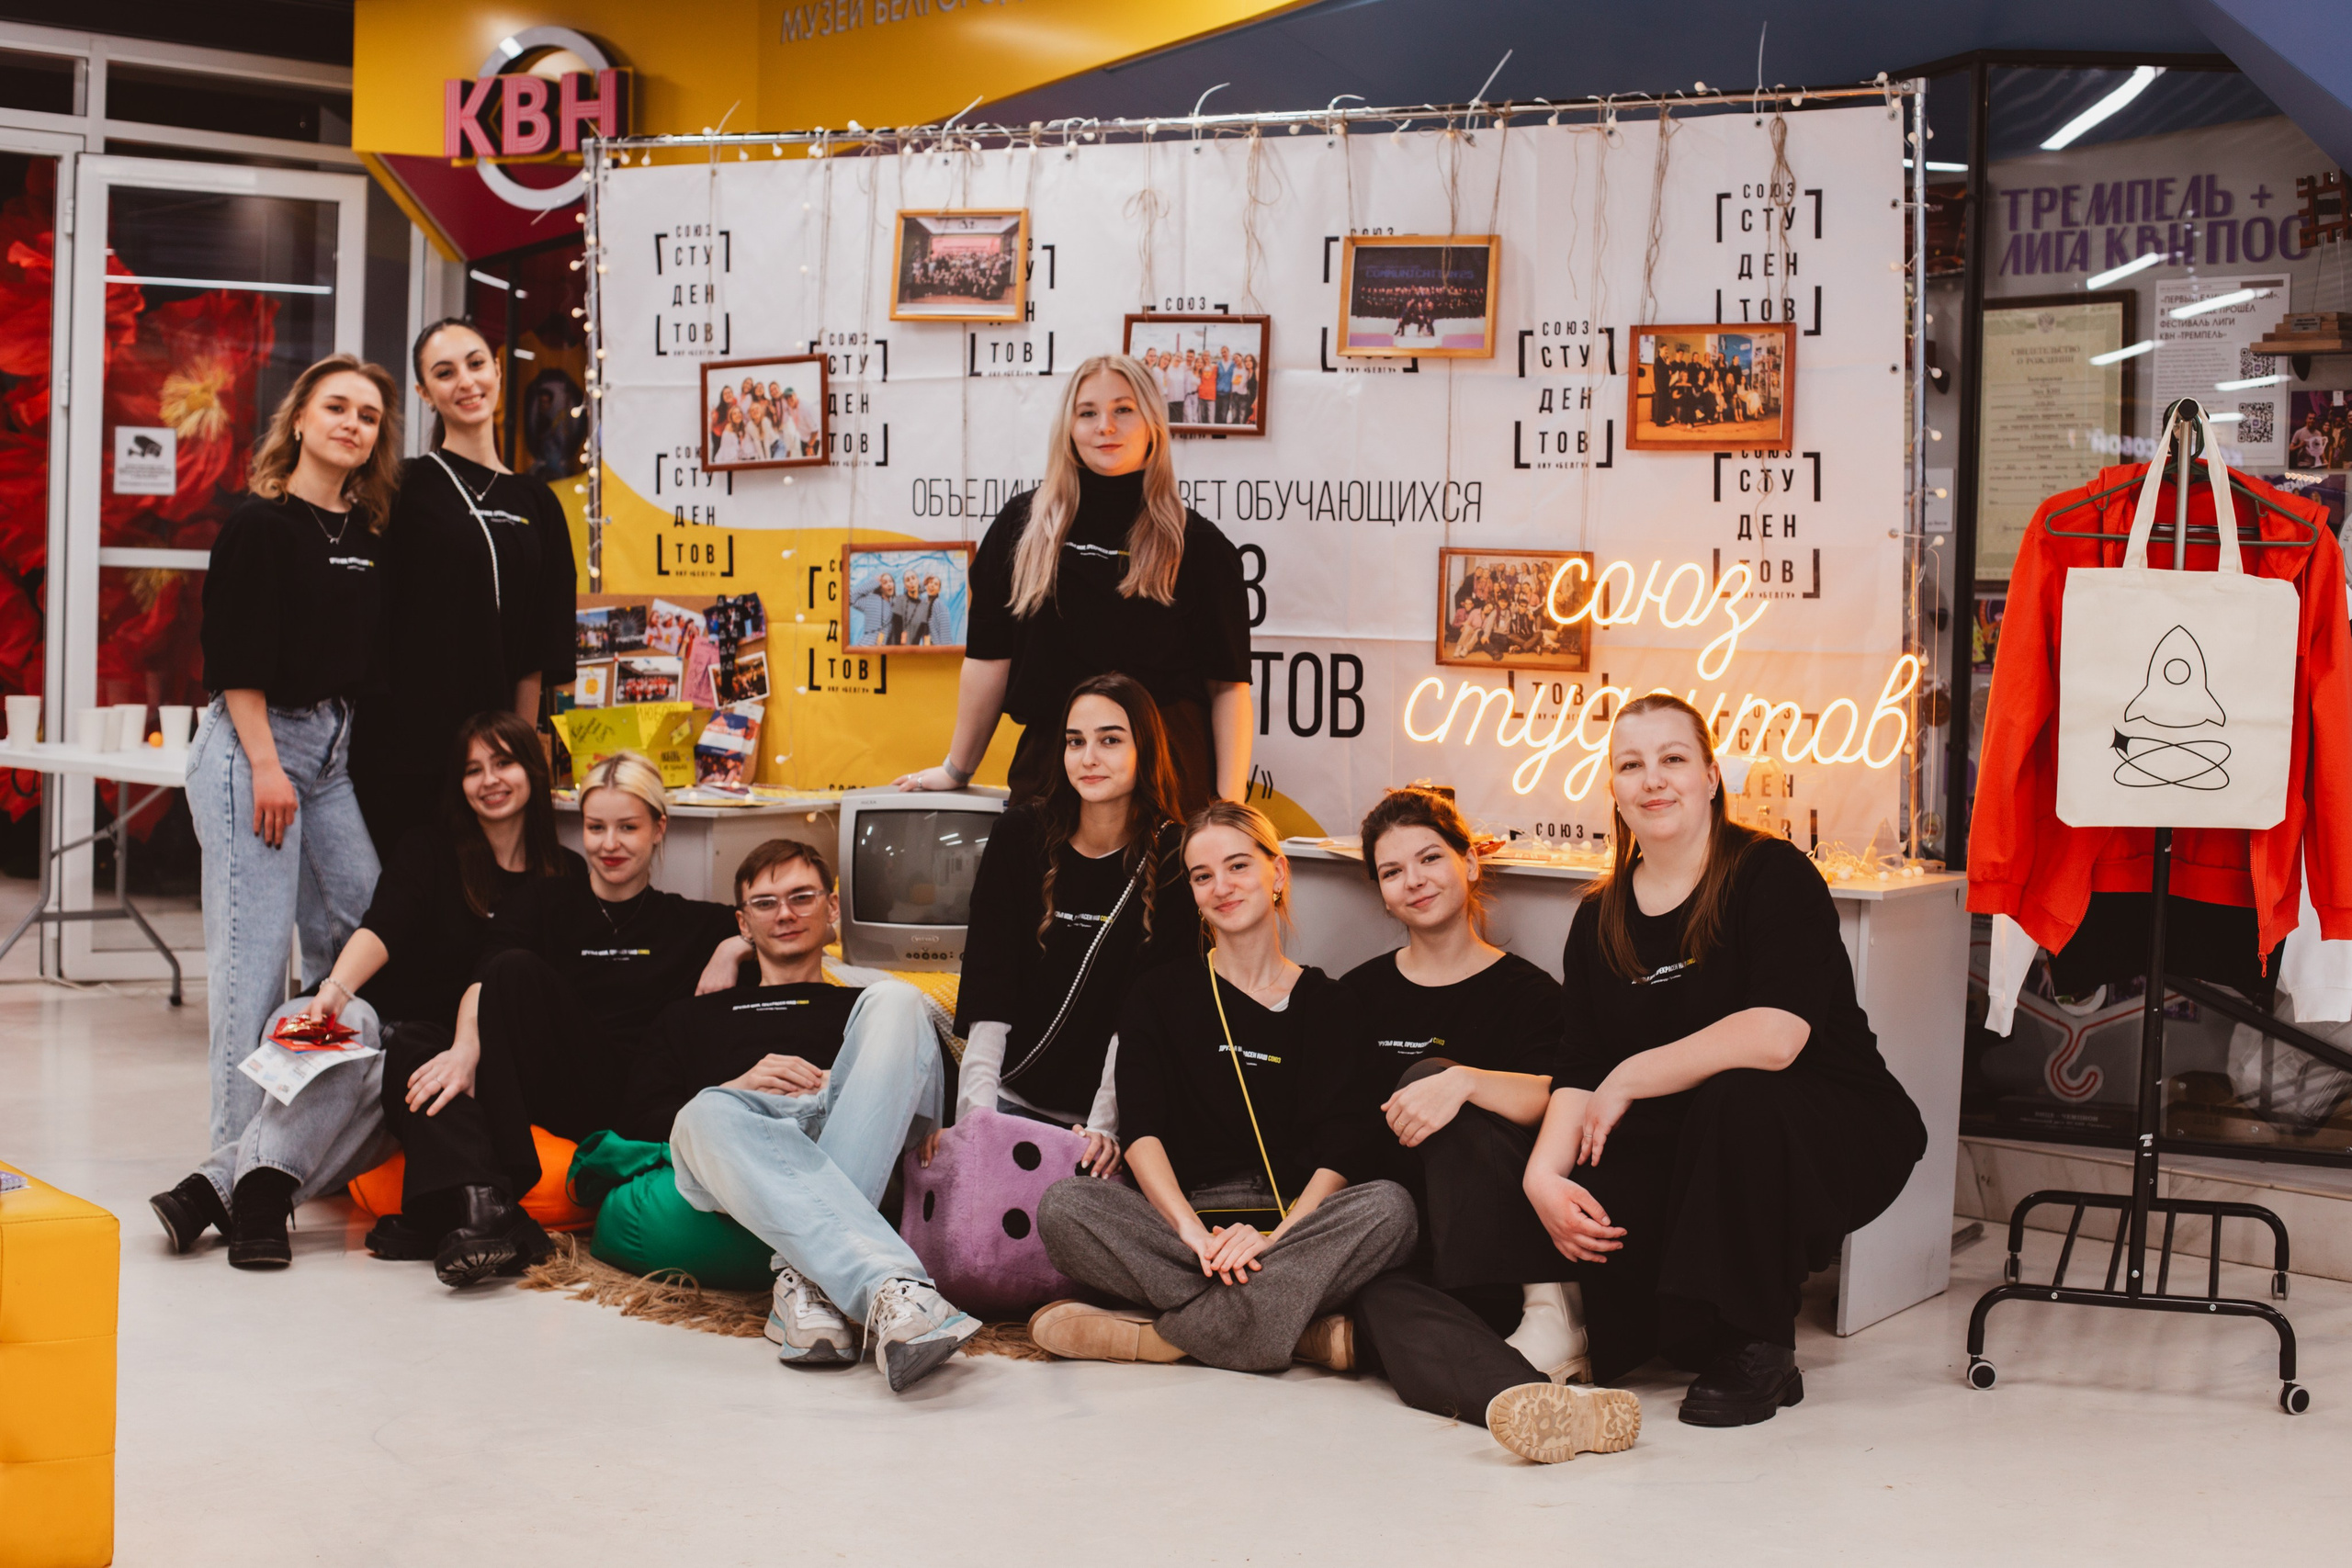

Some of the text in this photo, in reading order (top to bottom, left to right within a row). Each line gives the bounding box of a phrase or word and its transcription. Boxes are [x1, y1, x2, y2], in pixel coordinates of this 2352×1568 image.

[444, 68, 619, 158] КВН
[1743, 182, 1794, 198] СОЮЗ
[2000, 174, 2233, 231] ТРЕМПЕЛЬ
[1741, 207, 1796, 232] СТУ
[675, 224, 711, 238] СОЮЗ
[675, 245, 713, 266] СТУ
[1999, 229, 2091, 276] ЛИГА
[2105, 222, 2195, 269] КВН
[1738, 252, 1797, 280] ДЕН
[673, 284, 714, 307] ДЕН
[1739, 298, 1795, 322] ТОВ
[673, 322, 713, 344] ТОВ
[1543, 321, 1589, 336] СОЮЗ
[2160, 318, 2235, 329] ФЕСТИВАЛЬ ЛИГИ
[829, 333, 868, 345] СОЮЗ
[990, 342, 1034, 363] ТОВ
[1541, 344, 1590, 368] СТУ
[828, 355, 868, 375] СТУ
[828, 393, 869, 416] ДЕН
[1539, 387, 1591, 413] ДЕН
[675, 446, 702, 458] СОЮ
[828, 434, 868, 454] ТОВ
[1539, 430, 1589, 454] ТОВ
[674, 468, 713, 487] СТУ
[1739, 468, 1794, 492] СТУ
[1178, 479, 1227, 521] ВЕТ
[1236, 479, 1483, 527] ОБУЧАЮЩИХСЯ
[673, 505, 715, 527] ДЕН
[1737, 514, 1796, 541] ДЕН
[675, 543, 715, 564] ТОВ
[828, 658, 868, 681] ТОВ
[1536, 823, 1584, 839] СОЮЗ
